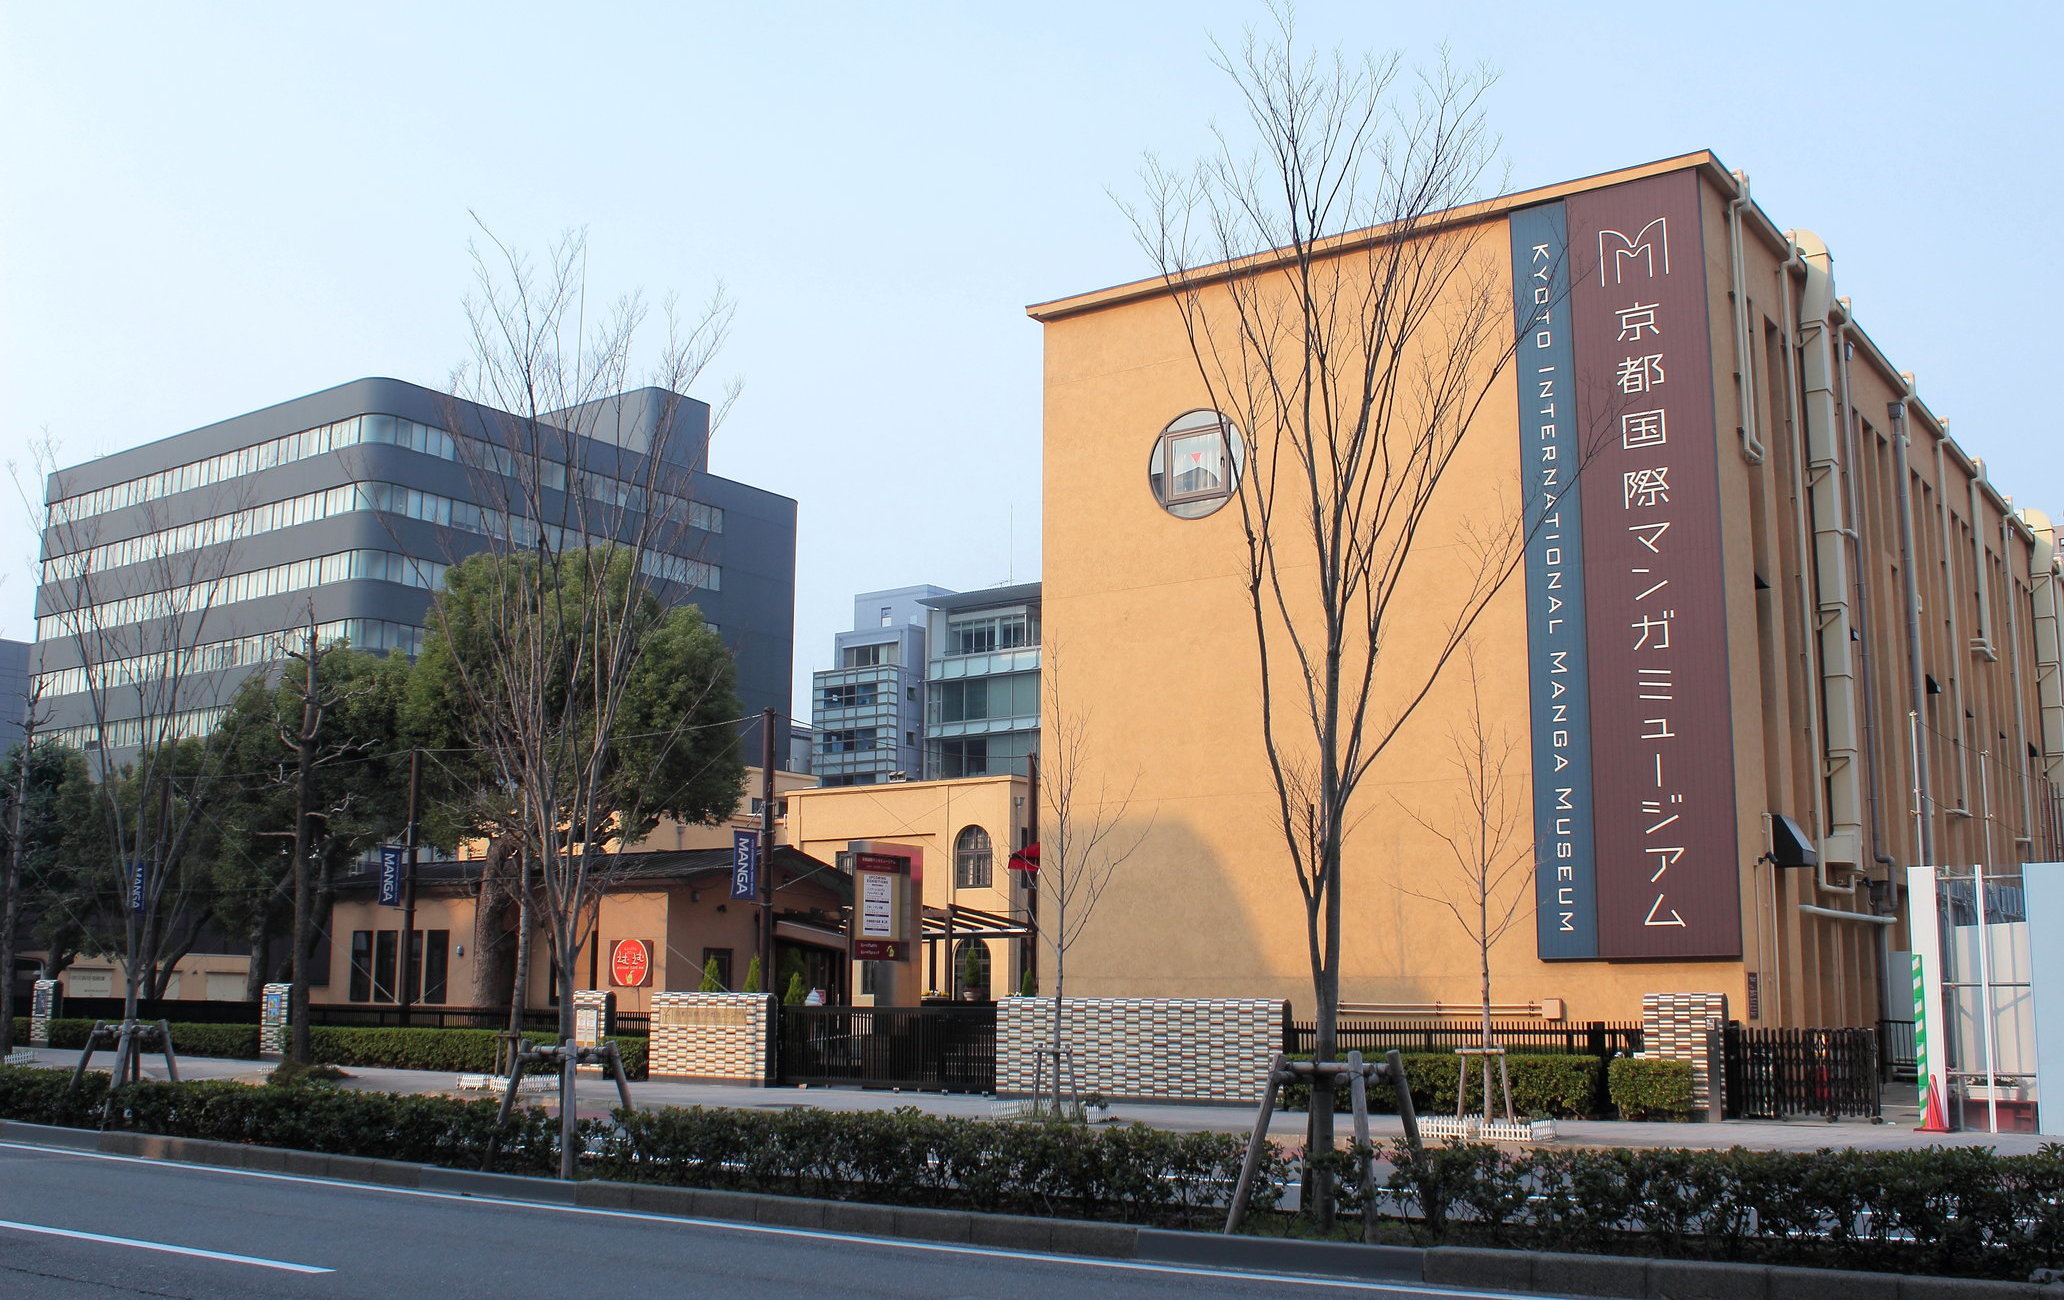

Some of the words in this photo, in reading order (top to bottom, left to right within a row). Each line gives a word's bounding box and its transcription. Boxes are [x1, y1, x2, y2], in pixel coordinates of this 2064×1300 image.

[1532, 242, 1552, 350] KYOTO
[1537, 366, 1565, 635] INTERNATIONAL
[1614, 301, 1687, 928] 京都国際マンガミュージアム
[1550, 651, 1570, 773] MANGA
[382, 853, 396, 902] MANGA
[736, 837, 750, 895] MANGA
[1554, 787, 1576, 932] MUSEUM
